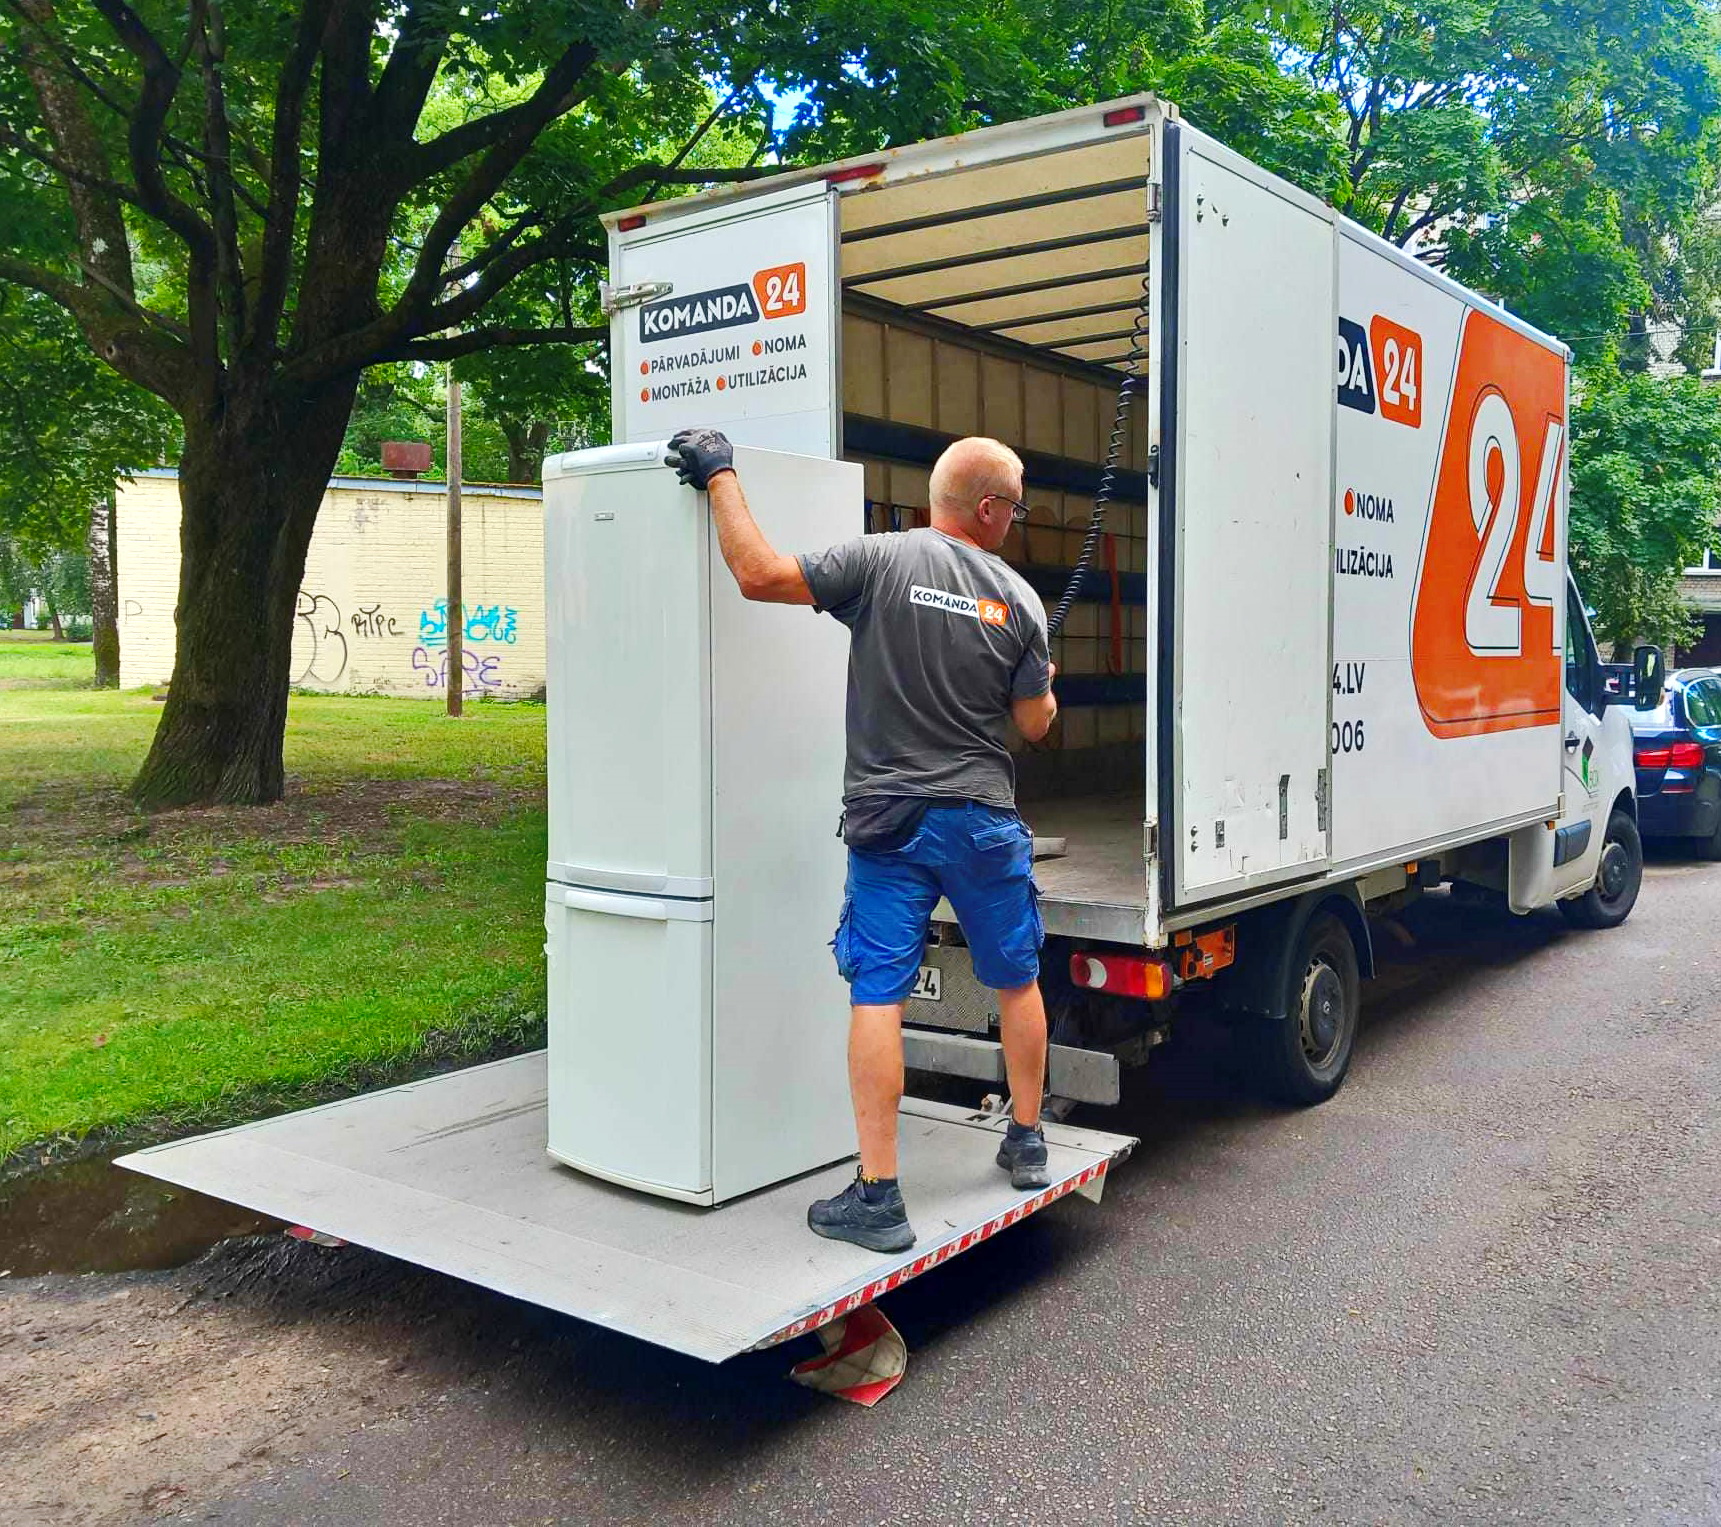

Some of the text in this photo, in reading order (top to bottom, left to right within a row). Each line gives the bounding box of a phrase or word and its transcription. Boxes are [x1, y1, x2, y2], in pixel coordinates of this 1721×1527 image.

[643, 271, 800, 335] KOMANDA 24
[650, 333, 807, 374] PĀRVADĀJUMI NOMA
[651, 363, 807, 402] MONTĀŽA UTILIZĀCIJA
[1383, 338, 1417, 411] 24
[1356, 492, 1394, 523] NOMA
[1465, 383, 1565, 657] 24
[913, 589, 1004, 622] KOMANDA 24
